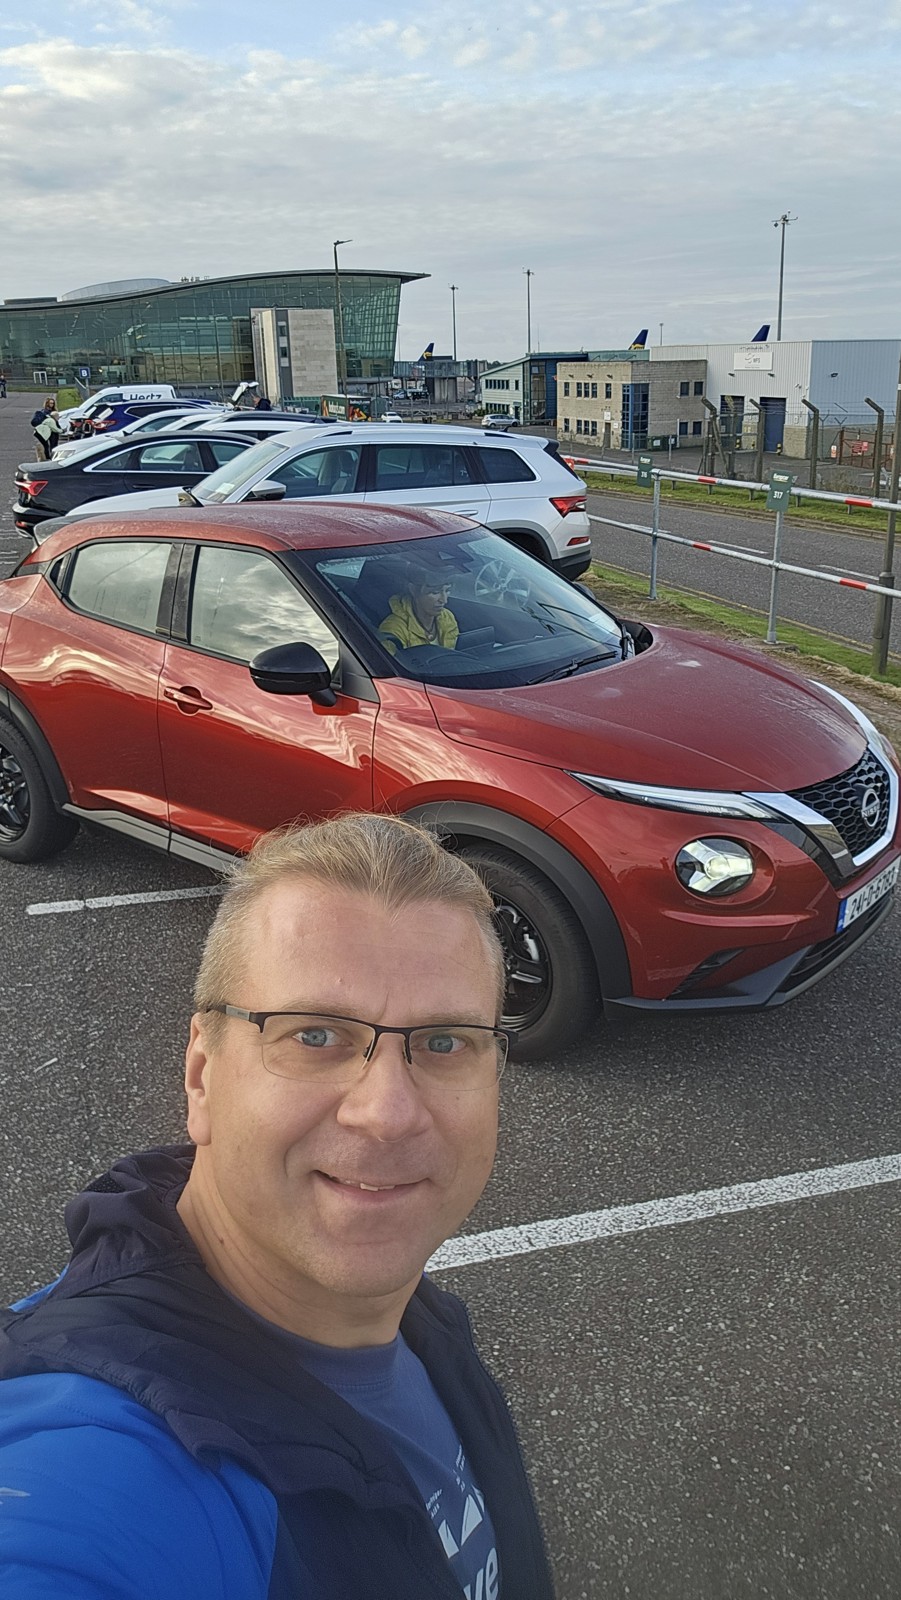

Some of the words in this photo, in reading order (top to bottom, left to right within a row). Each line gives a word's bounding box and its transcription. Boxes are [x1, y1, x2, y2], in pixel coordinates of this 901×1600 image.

[82, 369, 87, 377] B
[773, 490, 783, 499] 317
[861, 807, 880, 818] NISS
